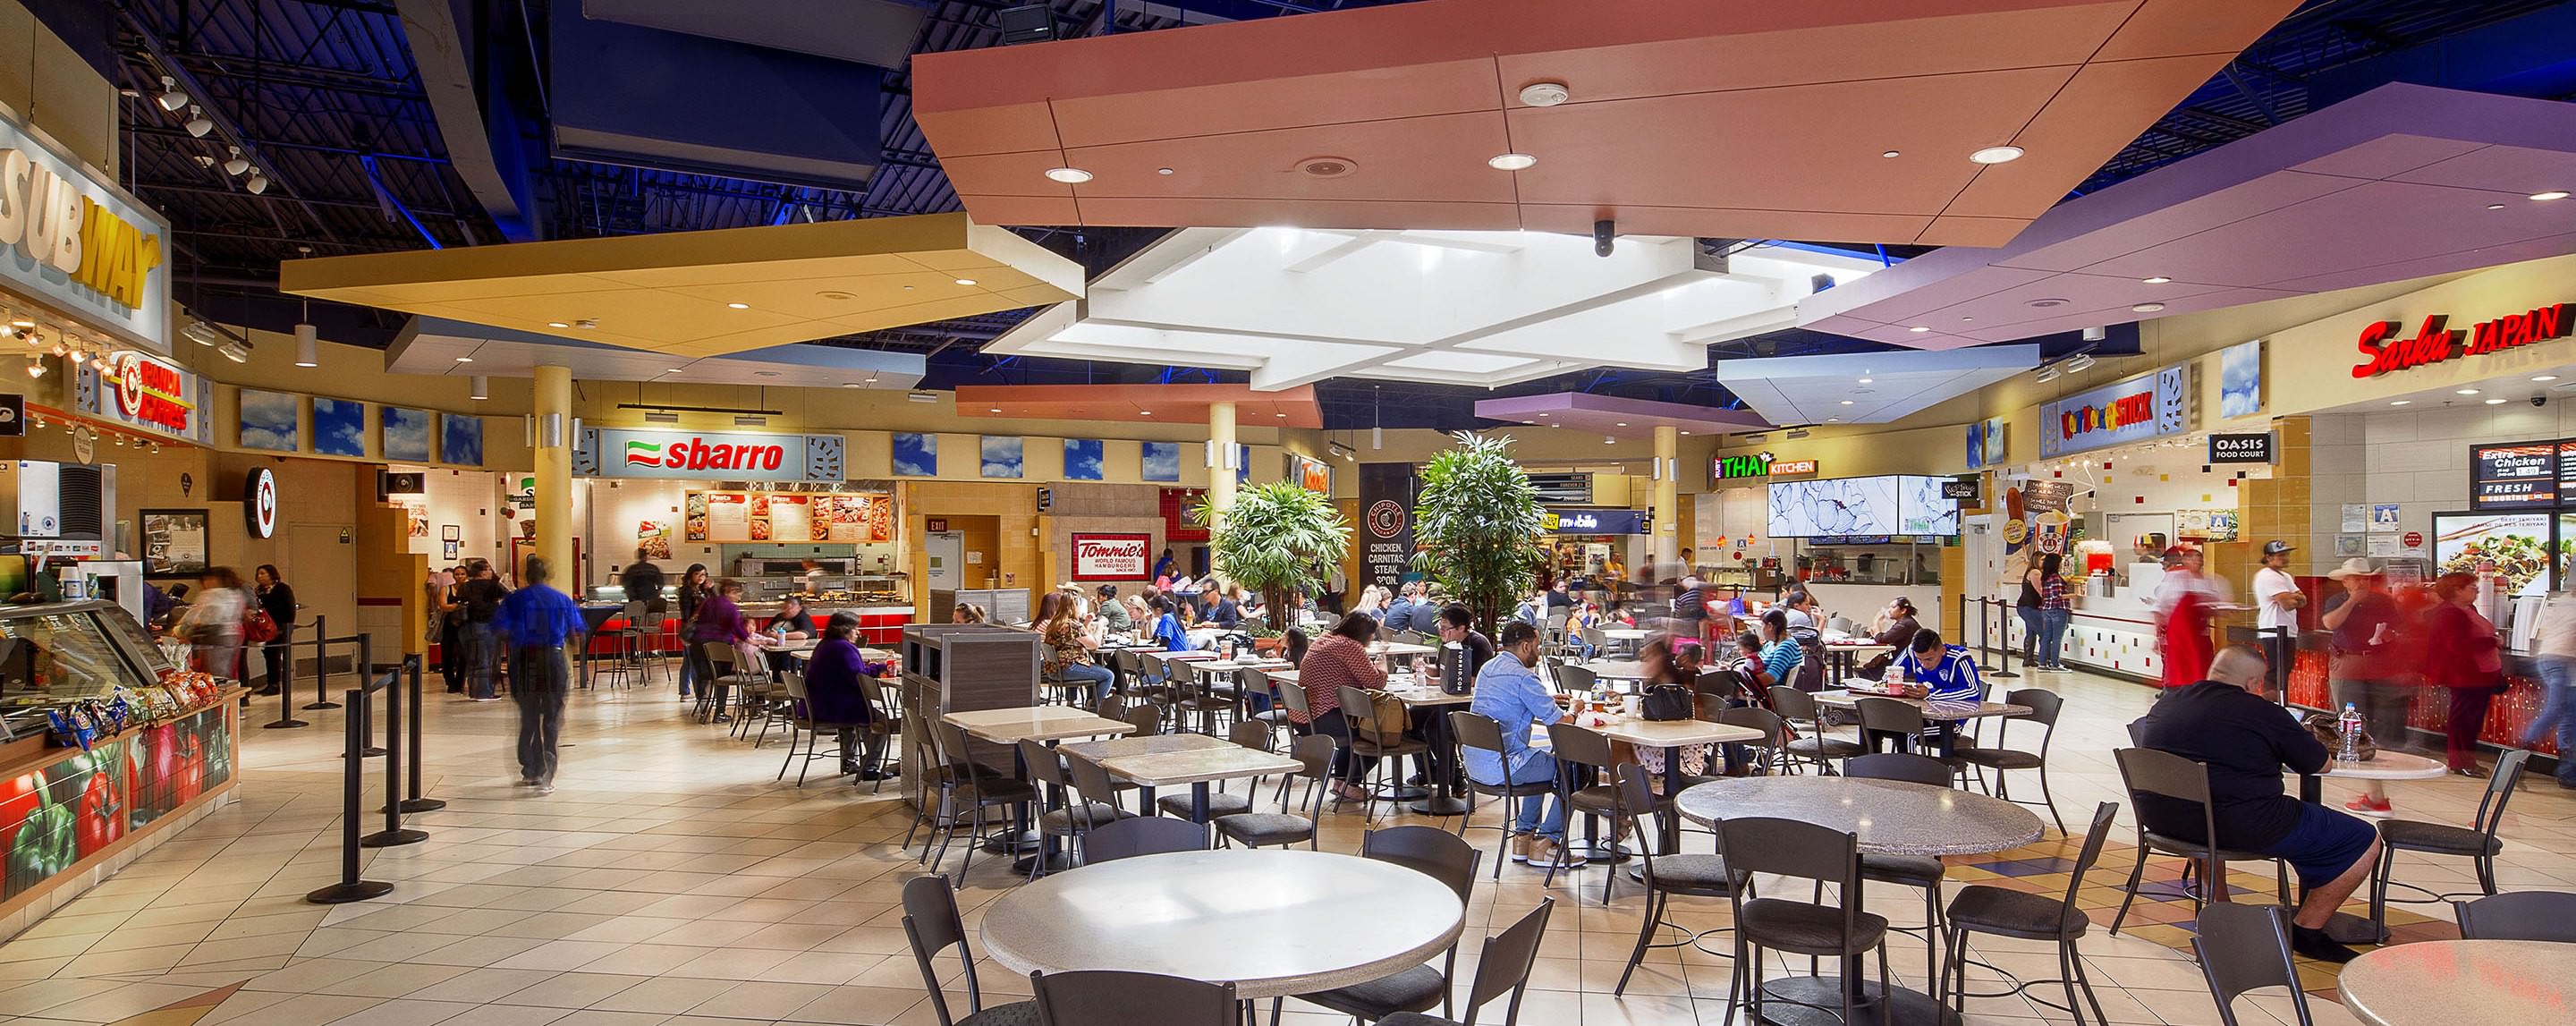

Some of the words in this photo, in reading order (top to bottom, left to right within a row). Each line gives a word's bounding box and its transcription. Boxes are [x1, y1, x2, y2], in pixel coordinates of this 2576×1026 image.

[0, 148, 162, 309] SUBWAY
[2352, 314, 2453, 378] Sarku
[2464, 302, 2563, 357] JAPAN
[140, 360, 182, 397] PANDA
[2116, 391, 2153, 427] STICK
[2216, 439, 2264, 450] OASIS
[665, 437, 784, 471] sbarro
[2482, 451, 2514, 460] Extra
[1771, 461, 1814, 474] KITCHEN
[2495, 457, 2546, 468] Chicken
[2486, 484, 2533, 494] FRESH
[1370, 502, 1402, 517] CHIPOTLE
[2379, 508, 2394, 522] A
[931, 521, 945, 530] EXIT
[2214, 517, 2224, 527] A
[447, 544, 454, 554] A
[1079, 542, 1145, 558] Tommie's
[1370, 543, 1404, 553] CHICKEN,
[1368, 554, 1406, 564] CARNITAS,
[1374, 564, 1400, 574] STEAK,
